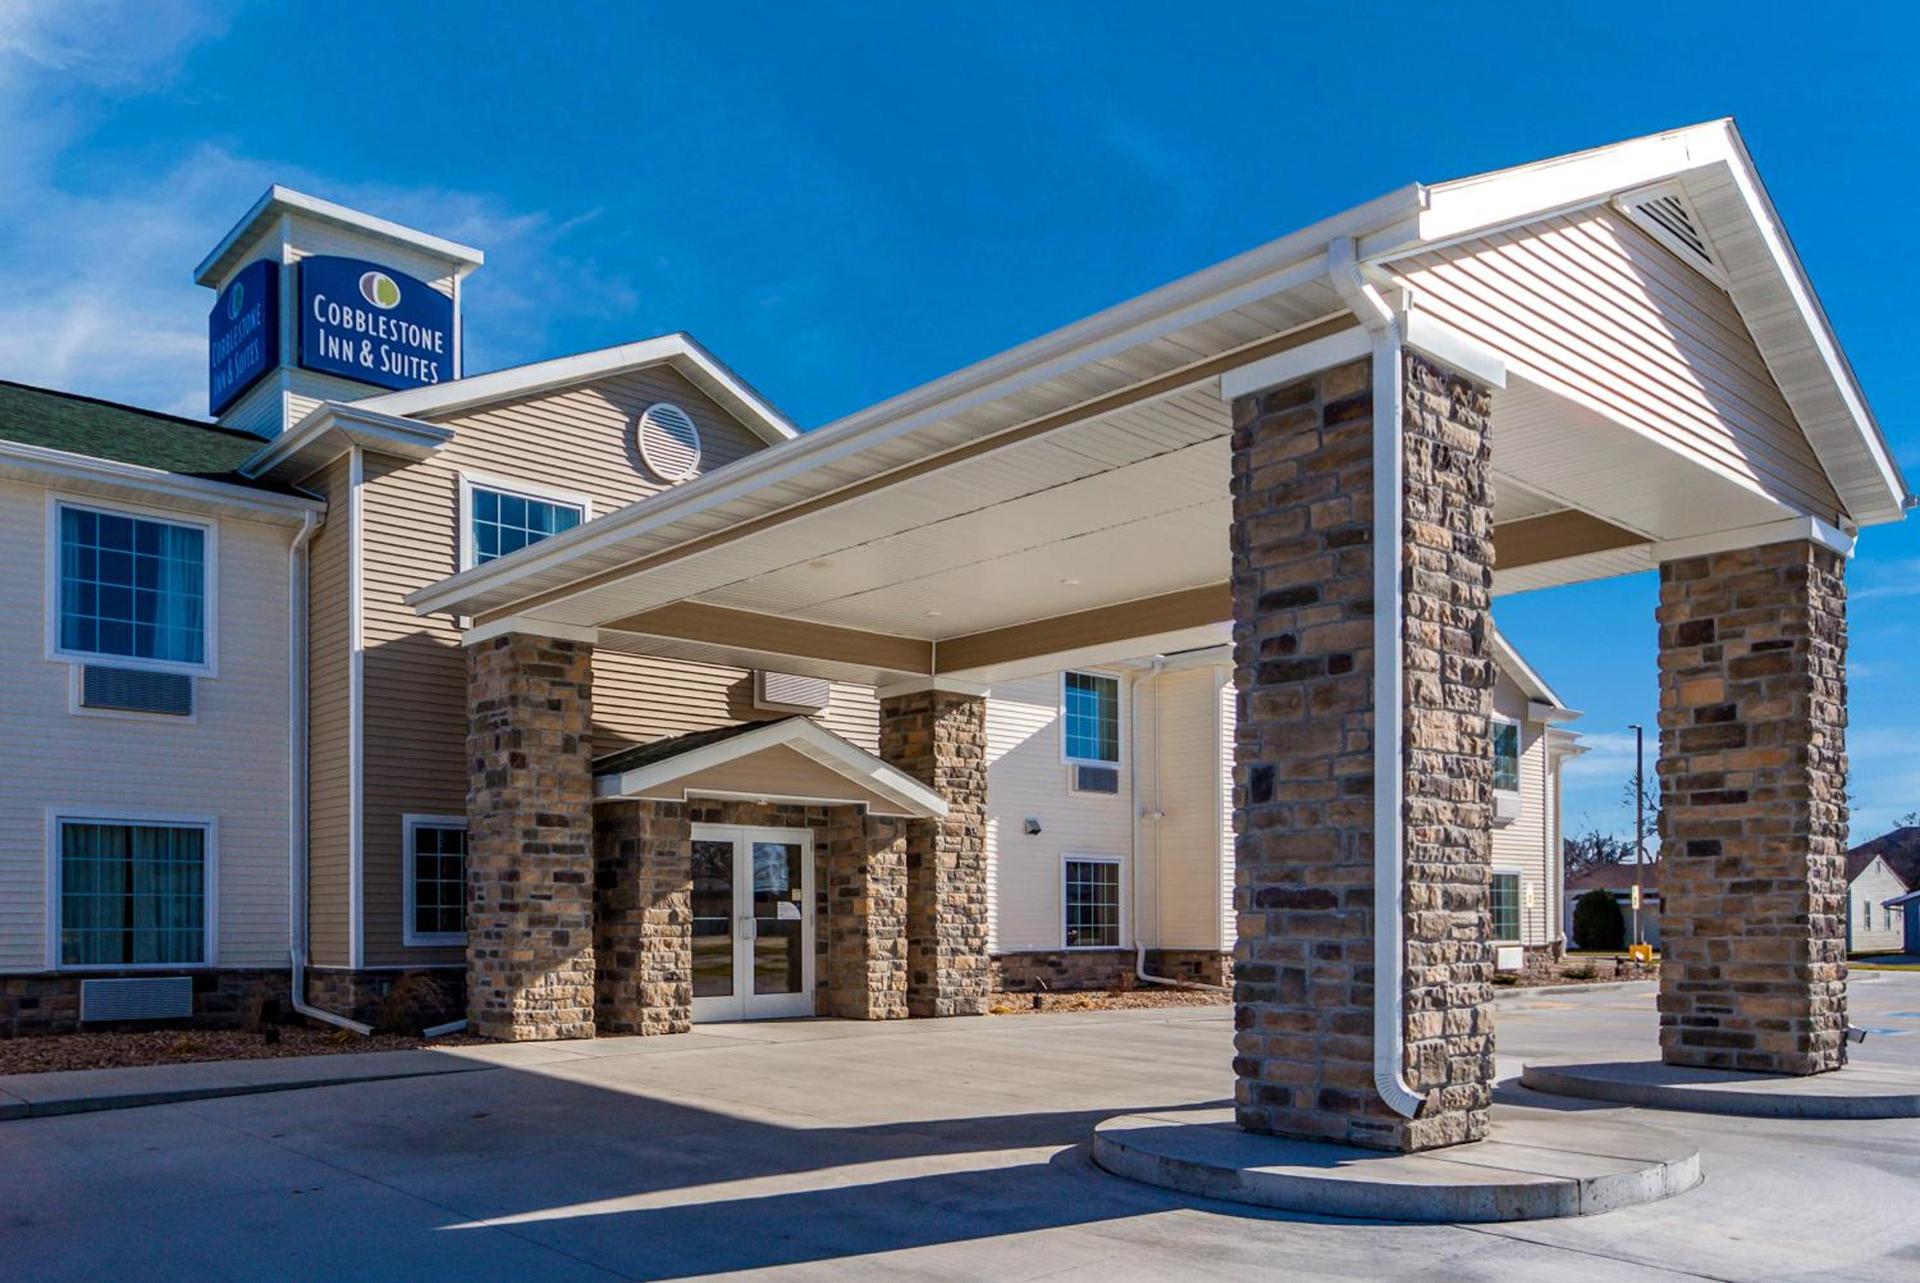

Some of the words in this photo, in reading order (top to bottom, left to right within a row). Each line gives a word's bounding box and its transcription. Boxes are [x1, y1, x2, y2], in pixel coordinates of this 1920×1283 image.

[314, 294, 444, 354] COBBLESTONE
[320, 328, 353, 363] INN
[360, 339, 374, 369] &
[380, 344, 439, 384] SUITES
